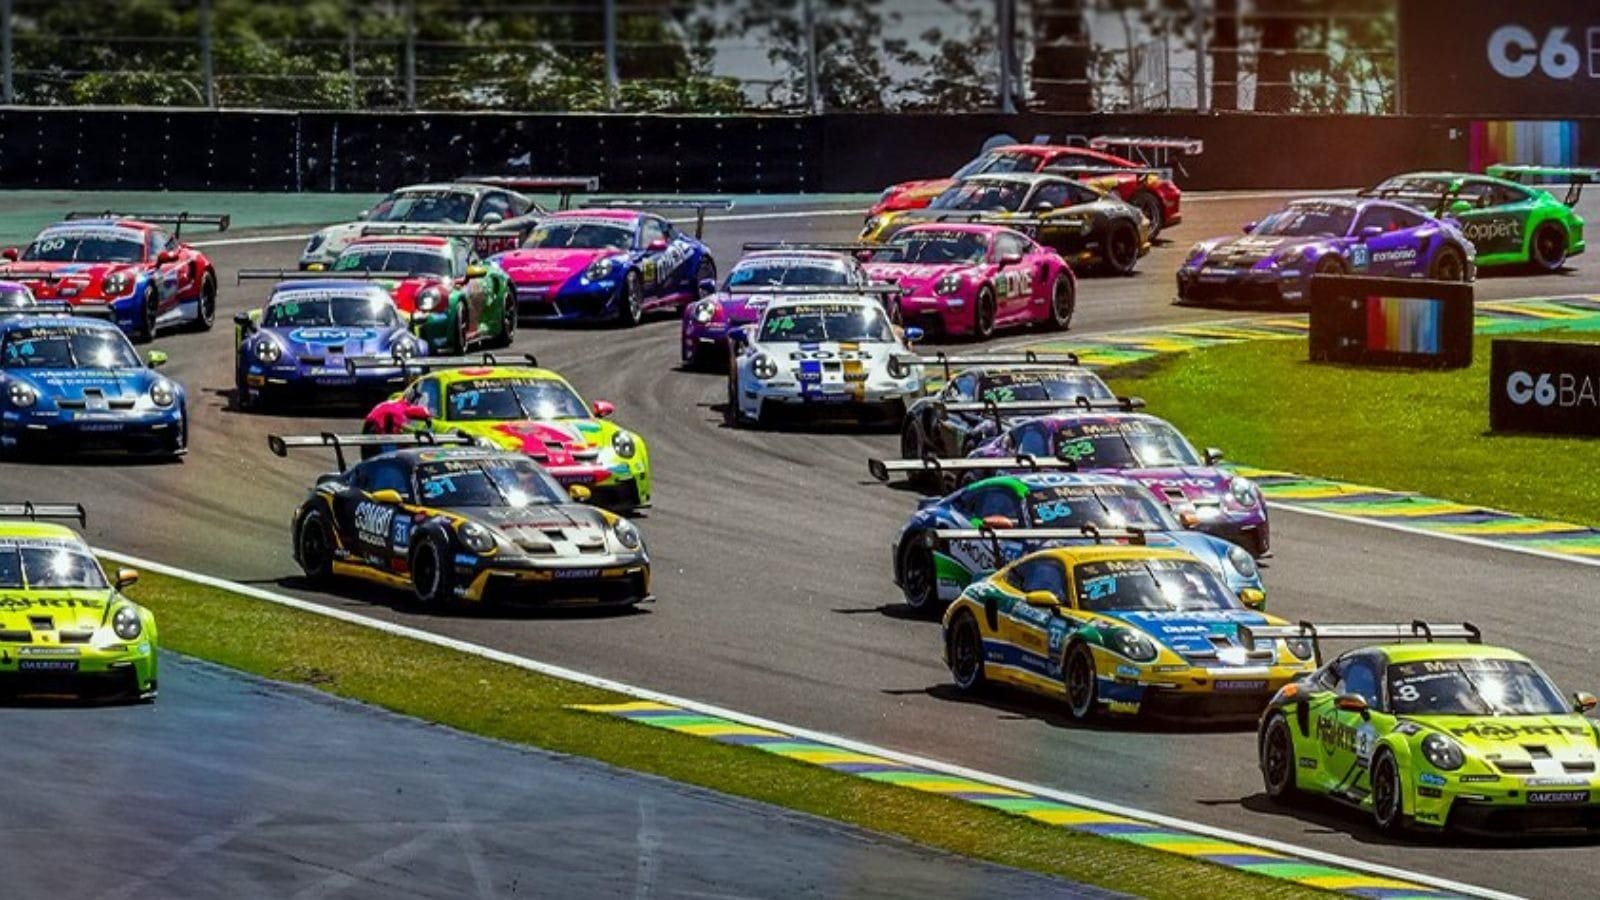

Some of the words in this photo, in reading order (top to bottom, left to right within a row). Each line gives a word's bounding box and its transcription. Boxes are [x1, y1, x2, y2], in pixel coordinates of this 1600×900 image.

[34, 238, 66, 254] 100
[452, 390, 480, 410] 77
[1084, 577, 1117, 600] 27
[1400, 684, 1420, 702] 8
